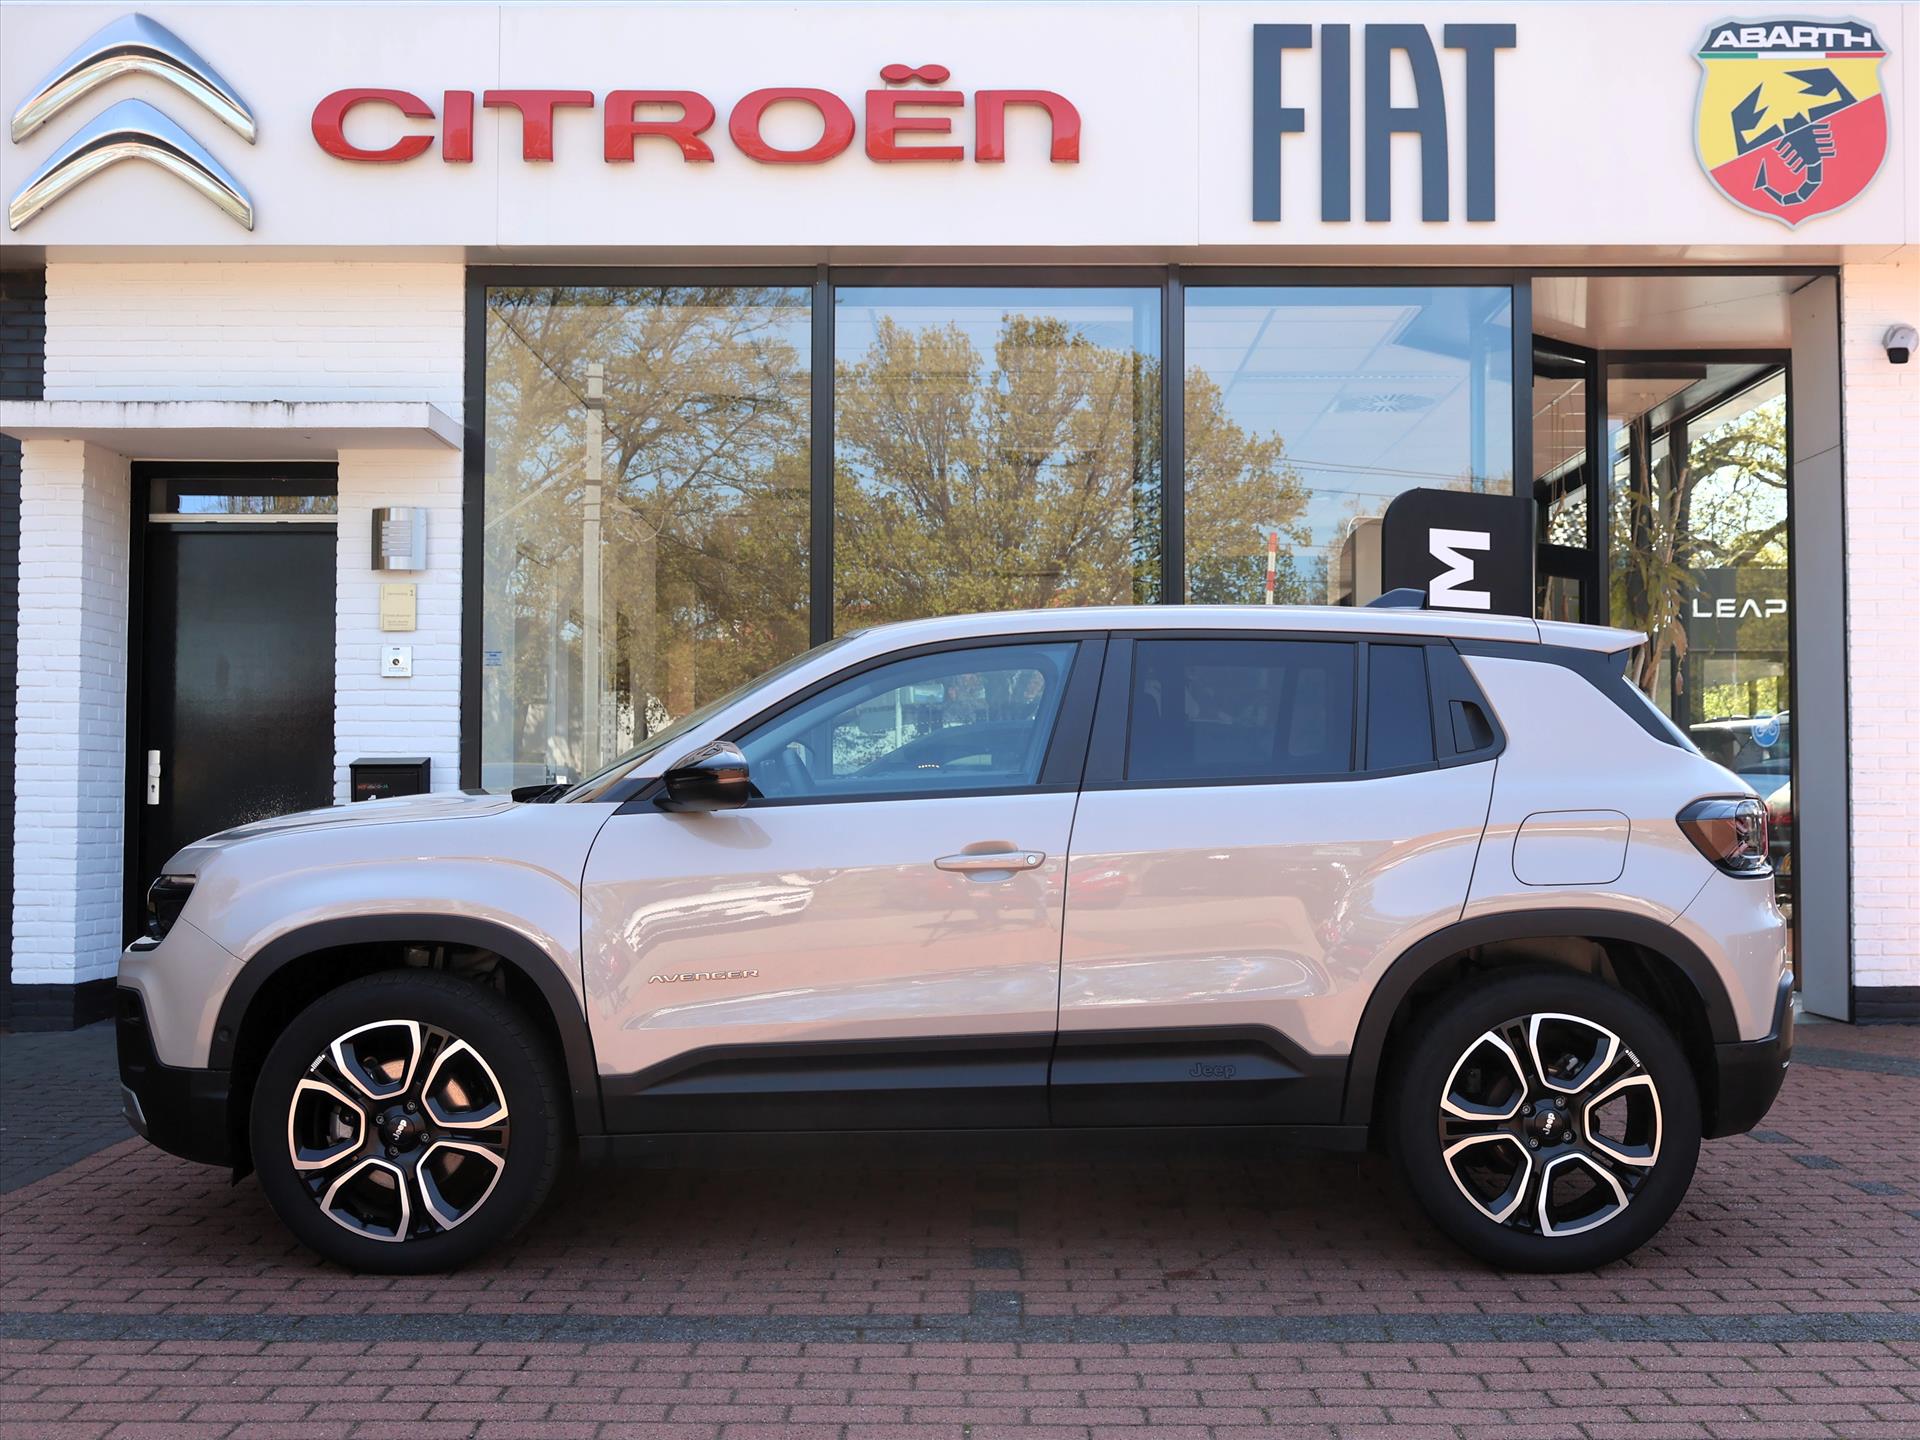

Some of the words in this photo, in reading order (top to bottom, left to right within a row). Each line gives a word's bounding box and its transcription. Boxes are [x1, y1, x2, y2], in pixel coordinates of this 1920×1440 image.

[1711, 25, 1872, 49] ABARTH
[311, 64, 1081, 164] CITROËN
[1252, 23, 1517, 223] FIAT
[1692, 598, 1788, 618] LEAP
[648, 968, 760, 984] AVENGER
[1188, 1062, 1236, 1079] Jeep
[392, 1119, 408, 1141] Jeep
[1542, 1112, 1556, 1135] Jeep
